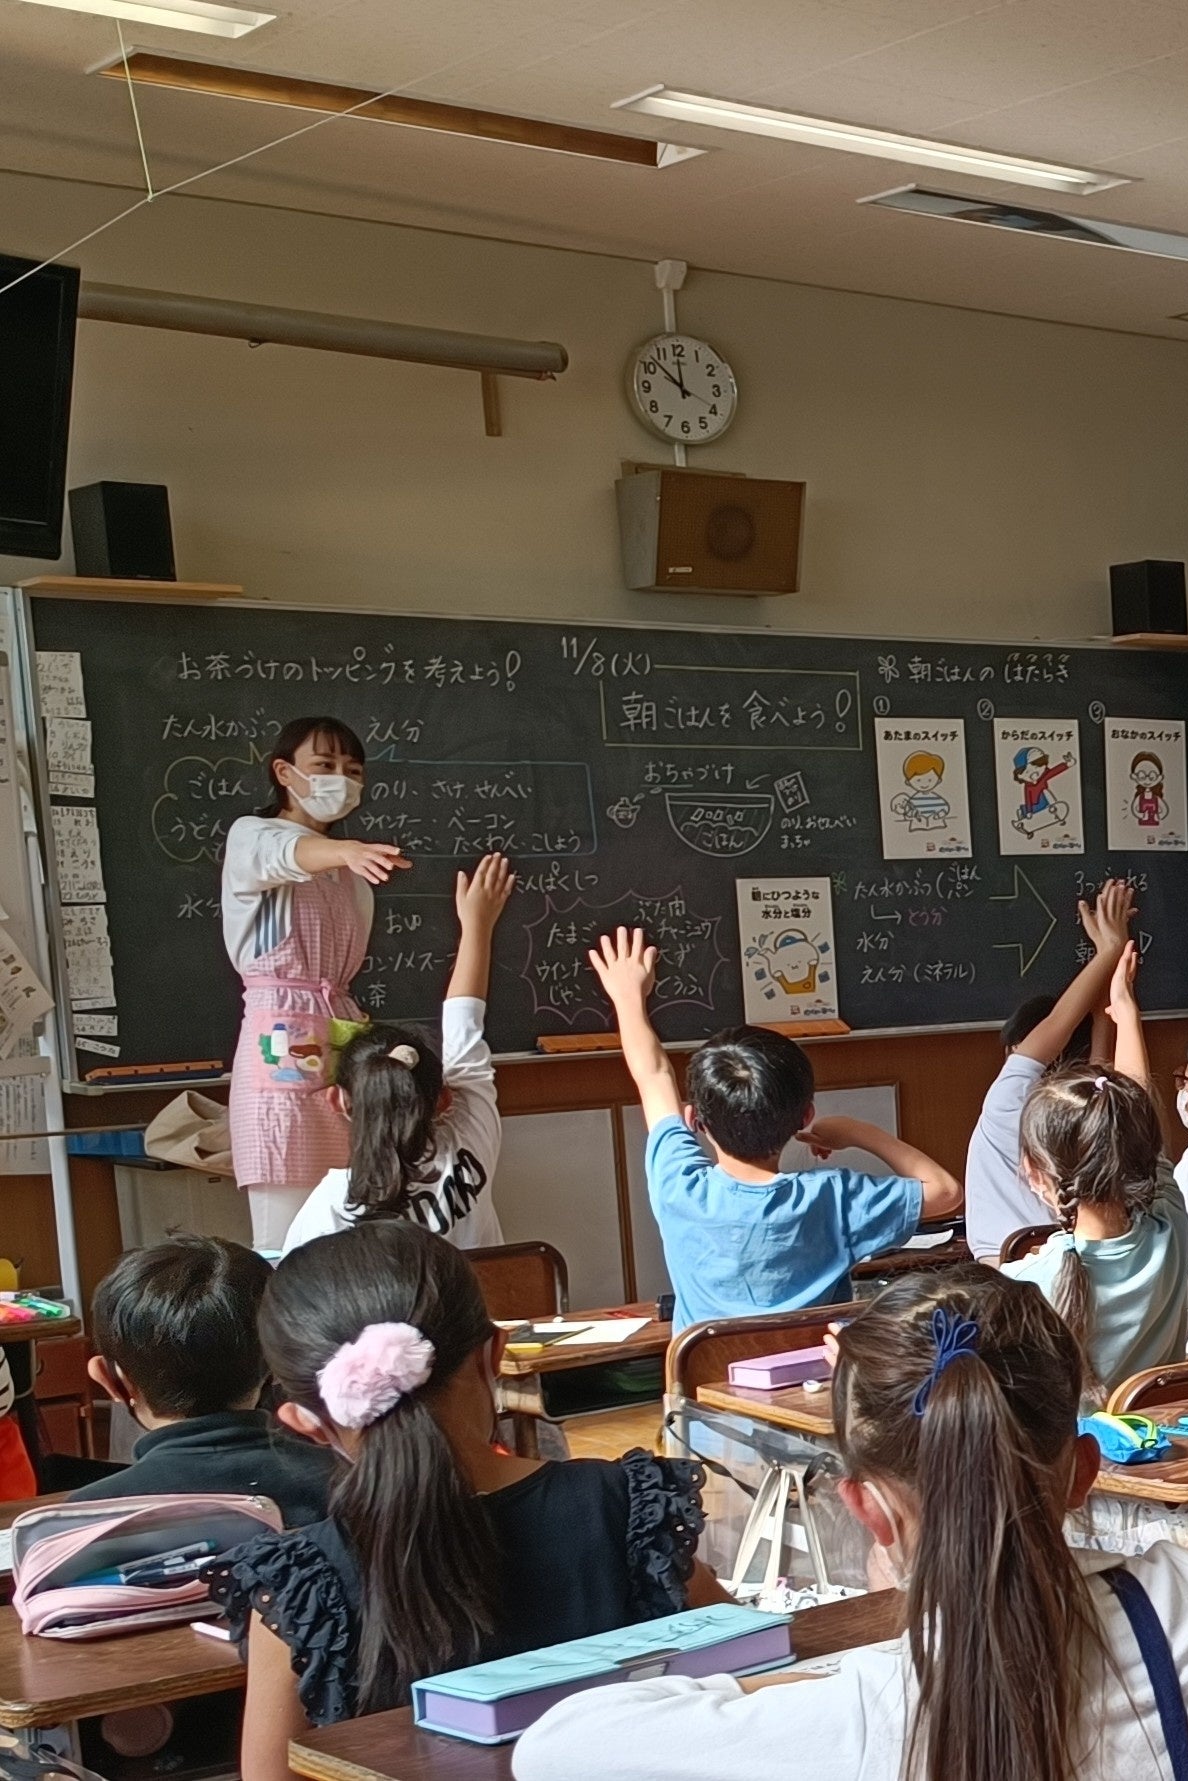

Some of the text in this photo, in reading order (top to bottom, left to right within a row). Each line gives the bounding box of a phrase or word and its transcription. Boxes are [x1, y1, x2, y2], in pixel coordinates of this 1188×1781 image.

[656, 347, 667, 361] 11
[671, 343, 685, 358] 12
[694, 349, 700, 363] 1
[639, 359, 657, 375] 10
[705, 363, 716, 377] 2
[641, 380, 652, 393] 9
[712, 384, 721, 398] 3
[649, 400, 659, 414] 8
[708, 403, 718, 417] 4
[663, 414, 674, 428] 7
[680, 420, 691, 434] 6
[698, 416, 708, 430] 5
[883, 730, 959, 742] あたまのスイッチ
[1001, 729, 1074, 742] からだのスイッチ
[1110, 729, 1182, 743] おなかのスイッチ
[644, 761, 734, 784] おちゃづけ
[702, 831, 744, 850] ごはん
[761, 907, 812, 919] 水分と塩分
[386, 908, 422, 935] おゆ
[547, 921, 597, 948] たまご
[856, 931, 894, 952] 水分
